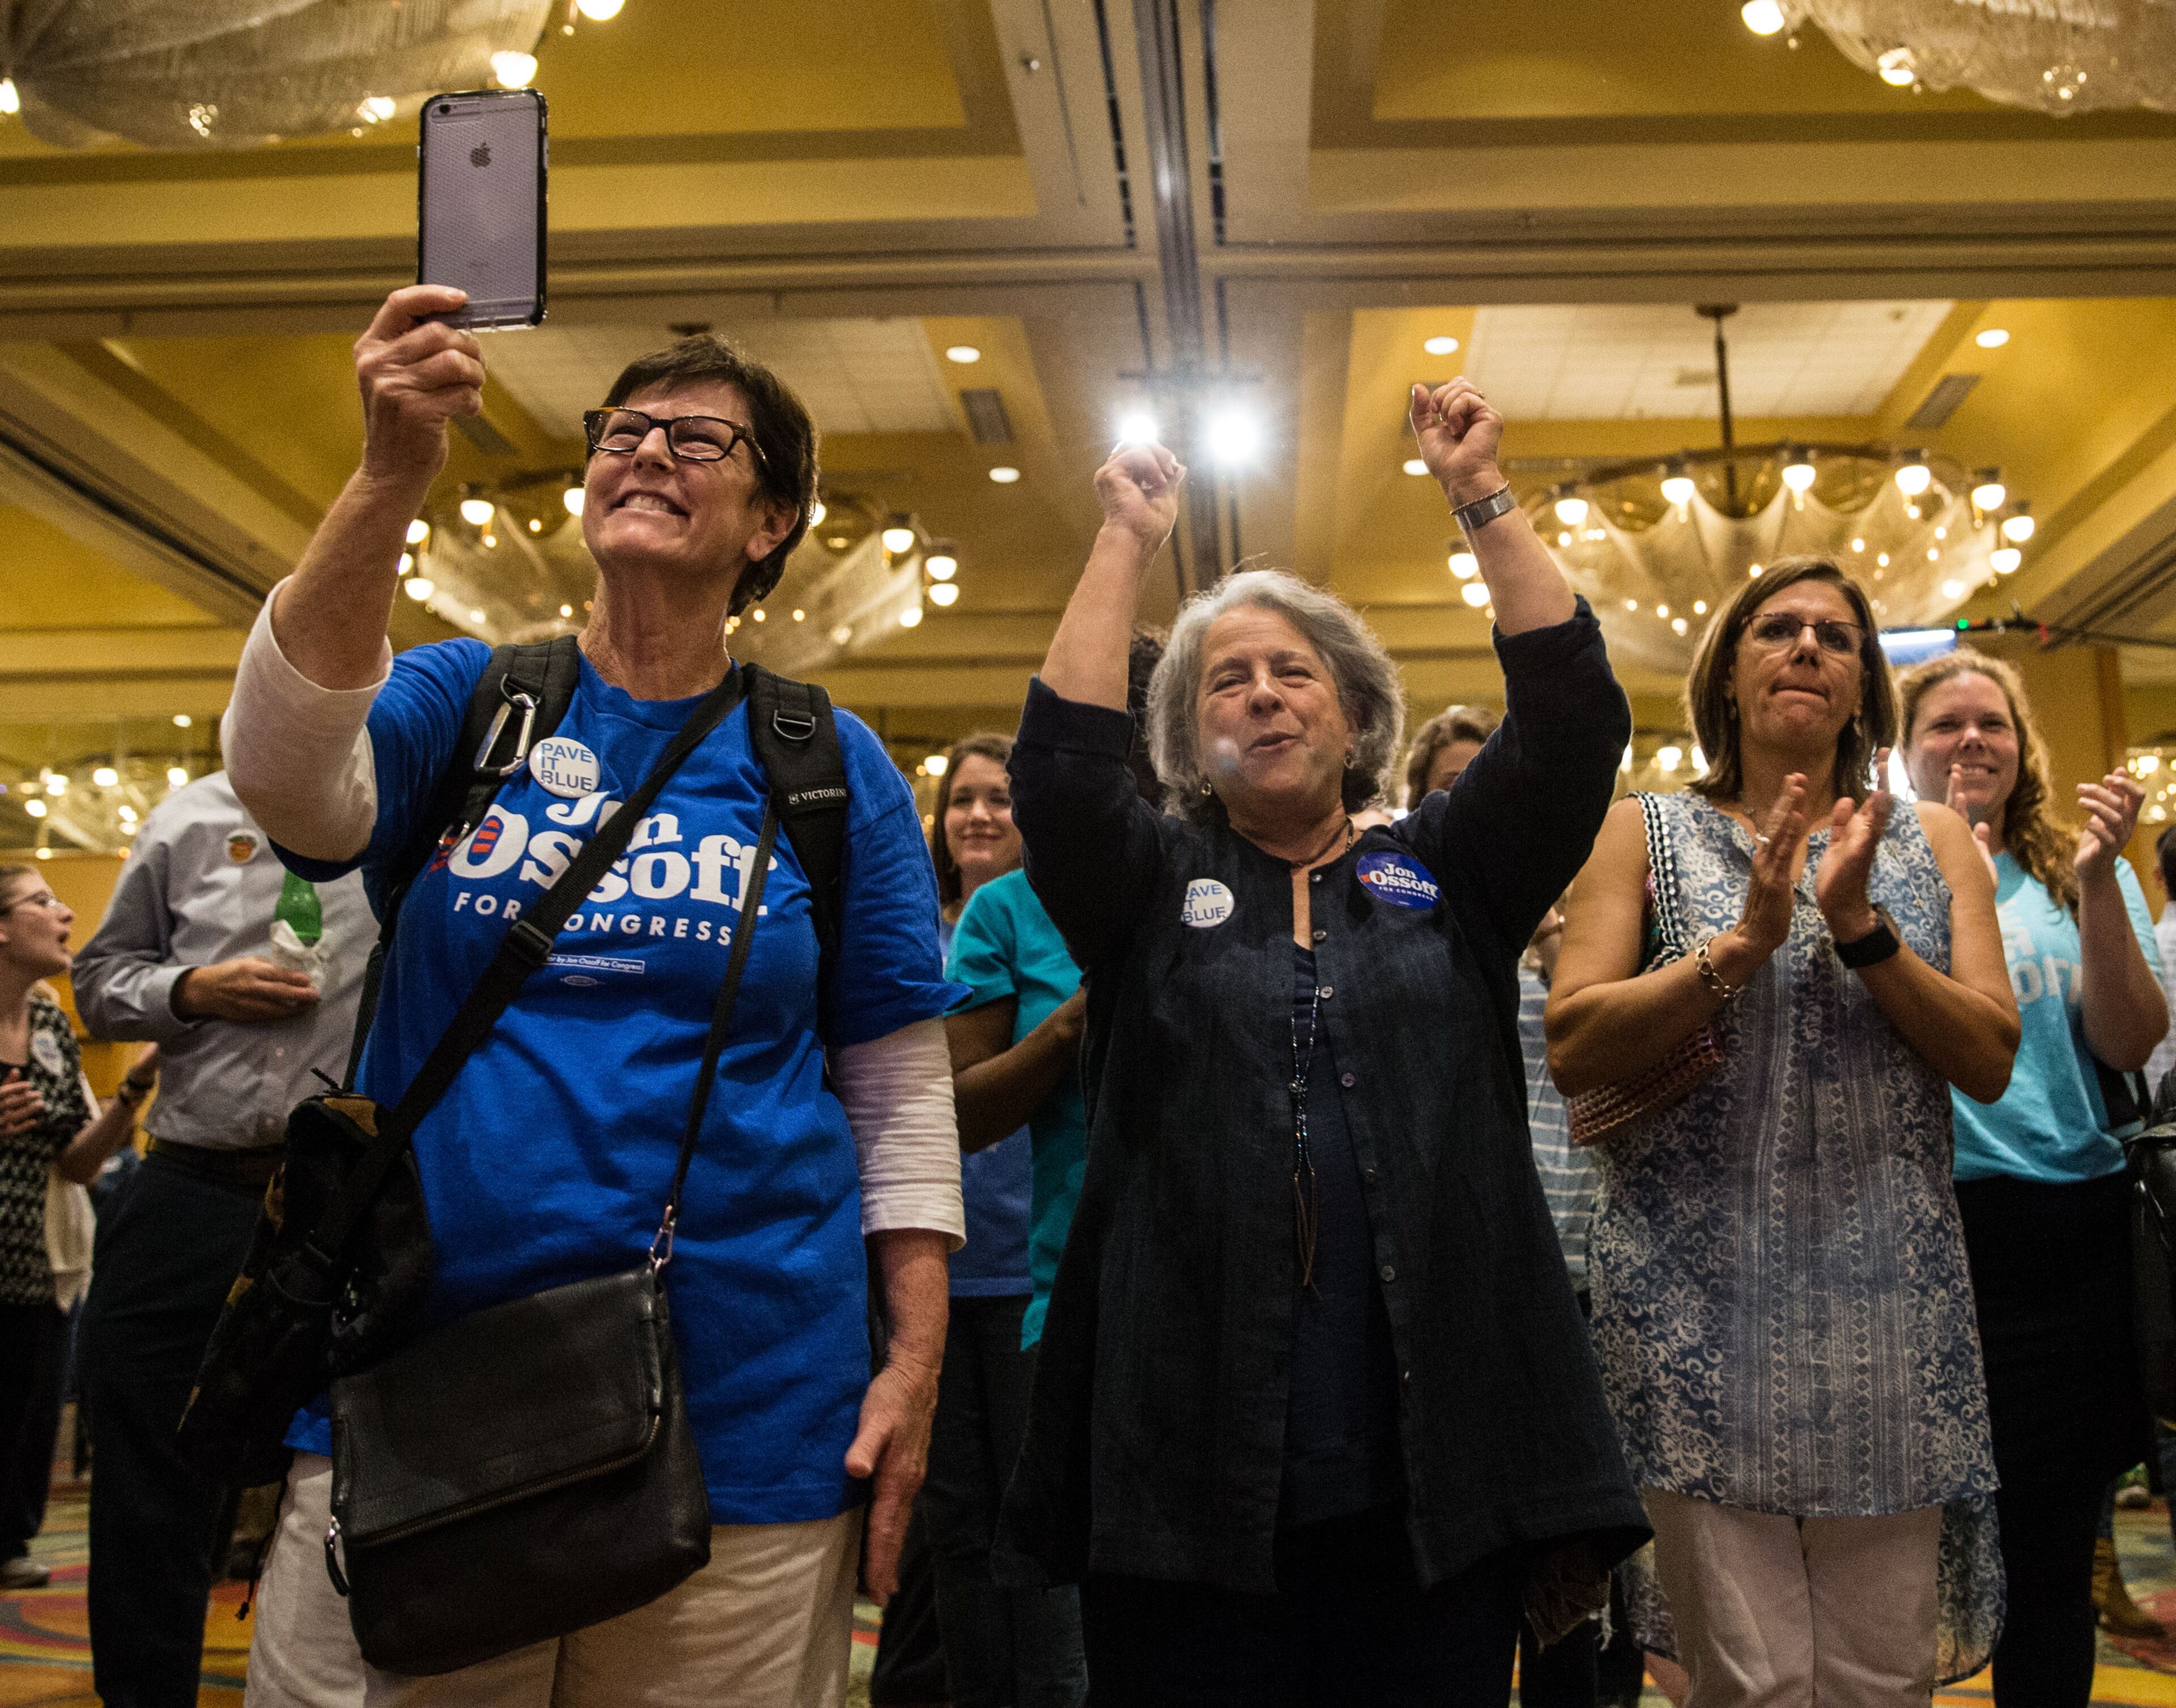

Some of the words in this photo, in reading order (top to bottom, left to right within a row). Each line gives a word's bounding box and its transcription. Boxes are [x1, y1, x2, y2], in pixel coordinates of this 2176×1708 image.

[541, 743, 592, 763] PAVE
[541, 756, 560, 770] IT
[541, 770, 592, 792] BLUE
[801, 788, 847, 801] VICTORIN
[1384, 863, 1418, 880] Jon
[1189, 884, 1222, 898] AVE
[1369, 870, 1438, 899] Ossoff
[1185, 898, 1195, 910] T
[454, 892, 521, 920] FOR
[563, 913, 733, 947] ONGRESS
[1182, 906, 1227, 924] BLUE
